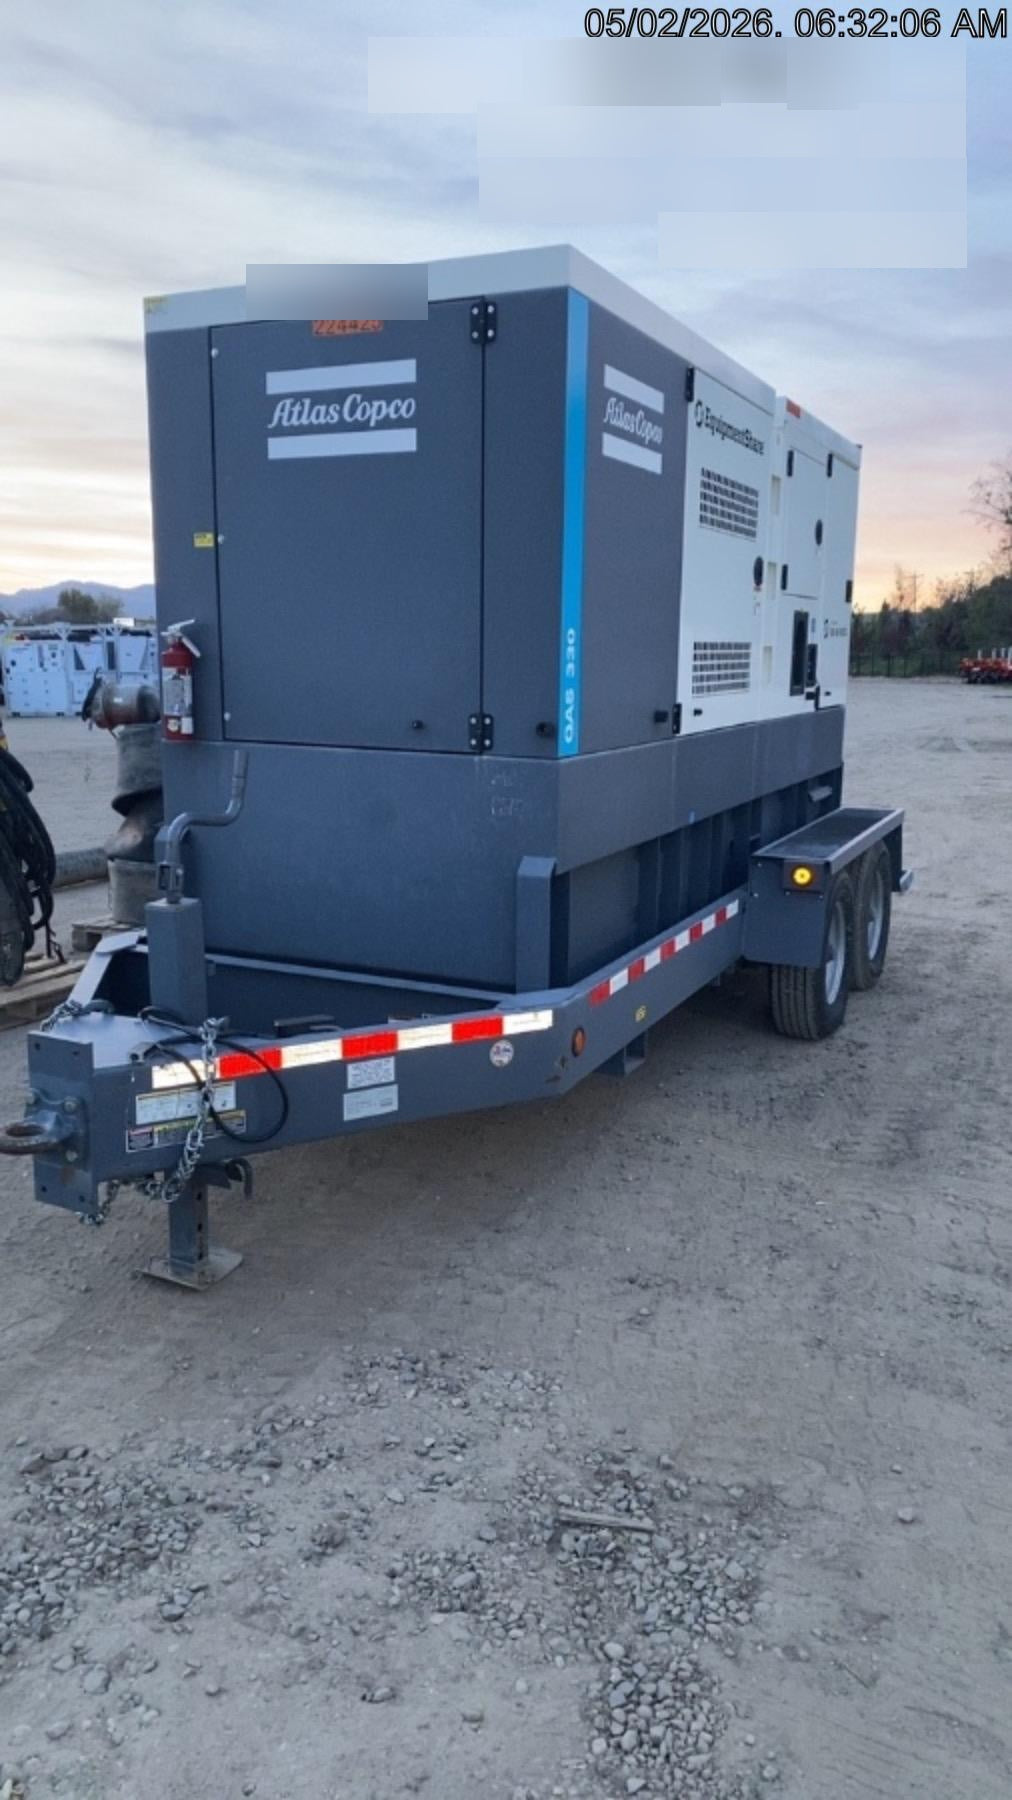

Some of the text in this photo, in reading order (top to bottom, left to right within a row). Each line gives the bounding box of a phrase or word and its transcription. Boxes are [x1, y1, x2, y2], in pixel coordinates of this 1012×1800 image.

[267, 393, 416, 429] Atlas Copco
[603, 397, 663, 444] Atlas Copco
[704, 406, 764, 456] EquipmentShare
[564, 628, 575, 744] QAS 330
